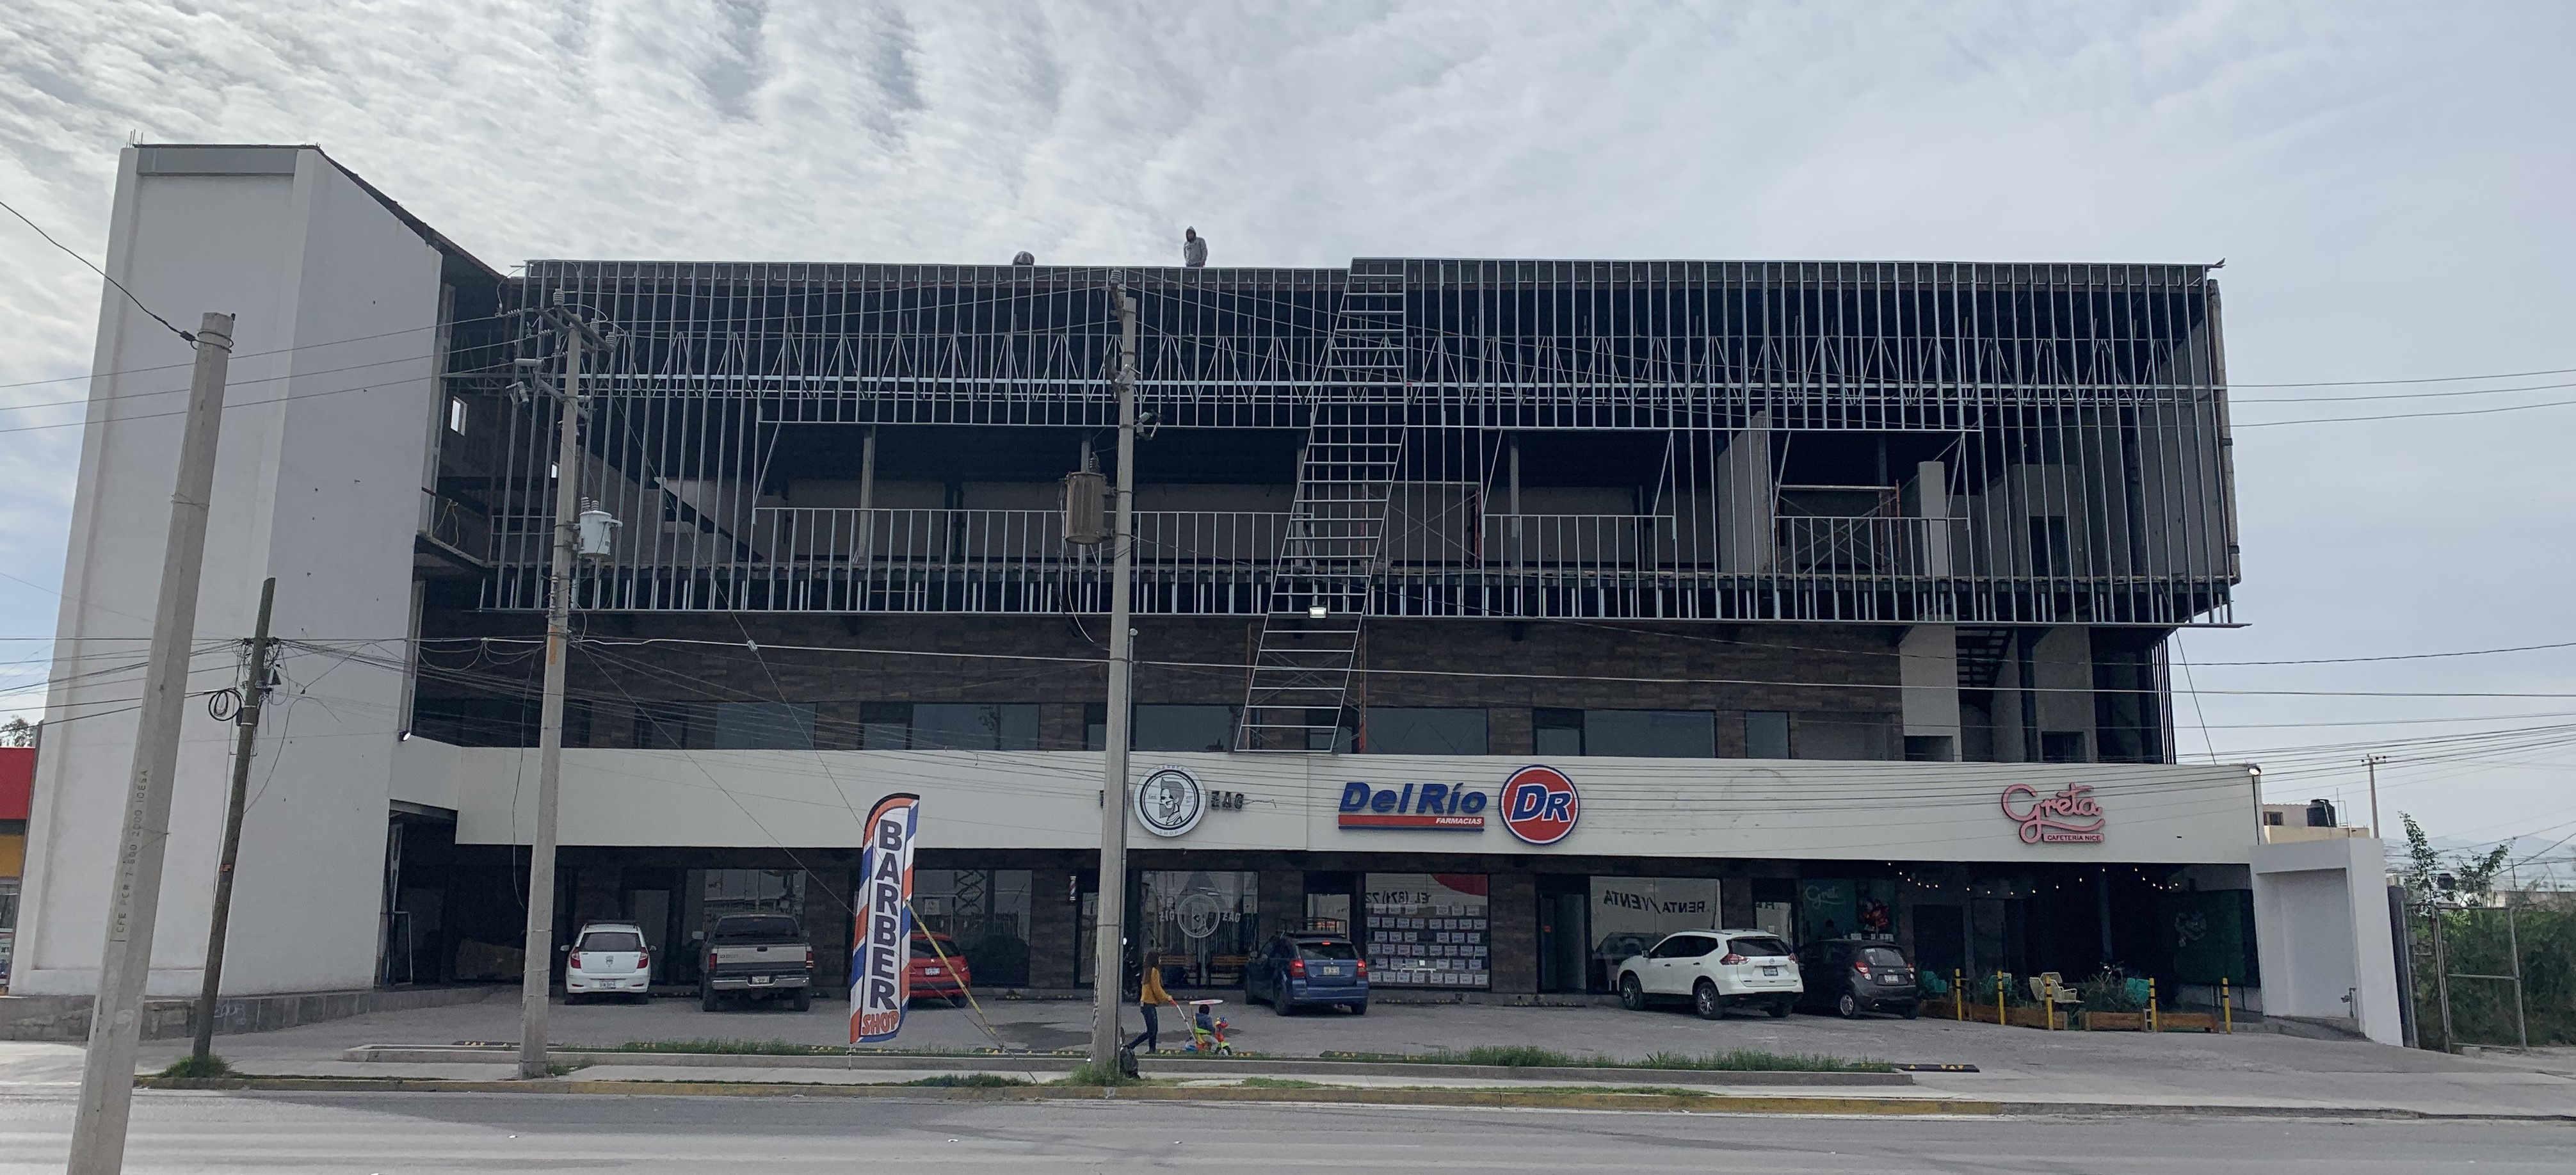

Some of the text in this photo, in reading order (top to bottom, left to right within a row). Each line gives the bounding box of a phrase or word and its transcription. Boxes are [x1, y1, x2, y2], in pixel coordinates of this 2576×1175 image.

[1339, 782, 1487, 814] Del Río
[1509, 782, 1572, 823] DR
[2001, 782, 2105, 843] Greta
[117, 912, 126, 933] CFE
[869, 819, 903, 1010] BARBER
[862, 1010, 899, 1036] SHOP
